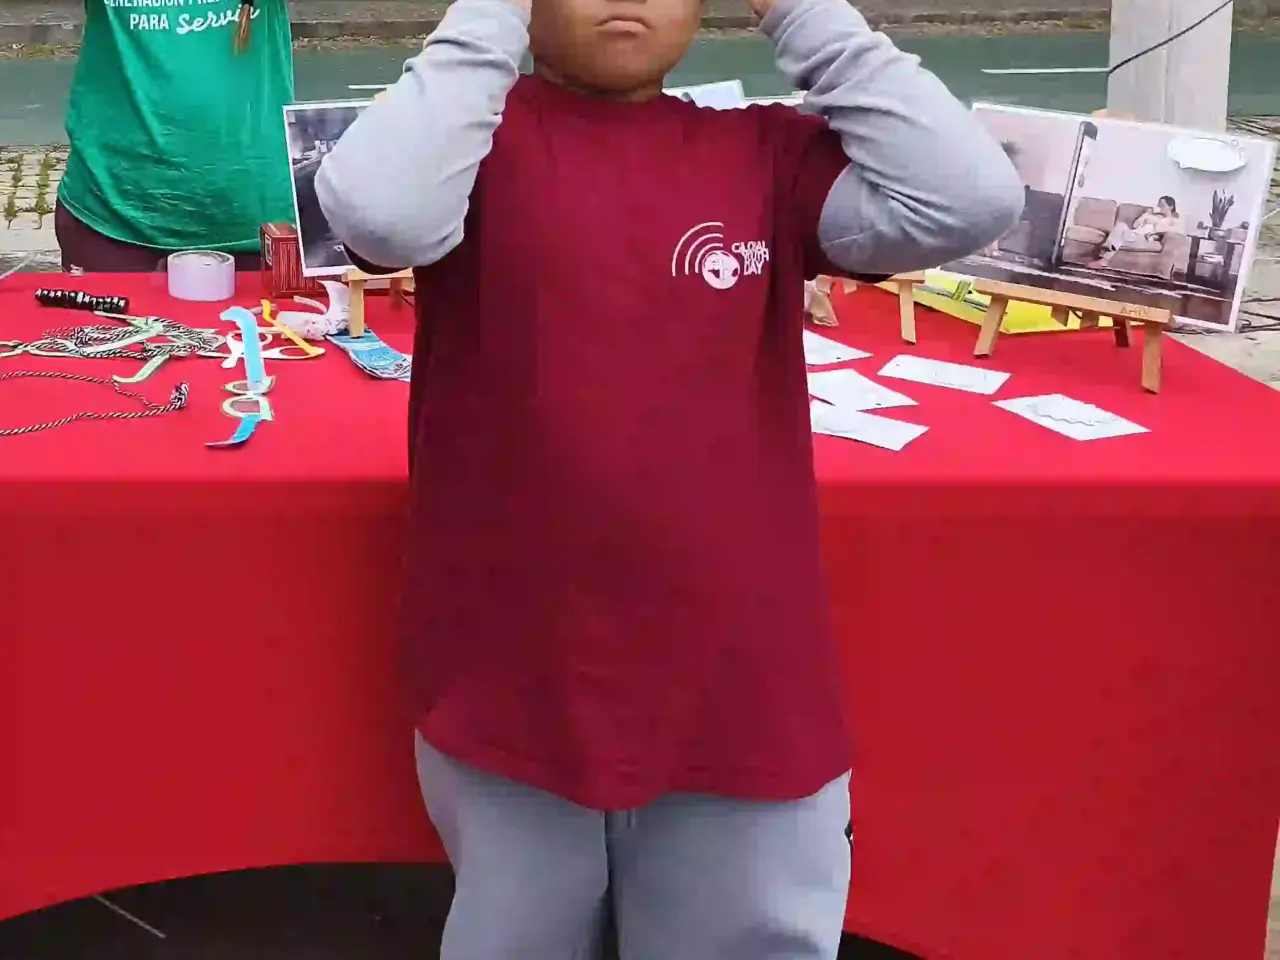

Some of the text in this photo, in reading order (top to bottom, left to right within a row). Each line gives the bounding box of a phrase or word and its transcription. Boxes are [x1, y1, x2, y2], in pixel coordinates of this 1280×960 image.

[129, 13, 169, 30] PARA
[740, 248, 769, 261] YOUTH
[744, 260, 764, 275] DAY
